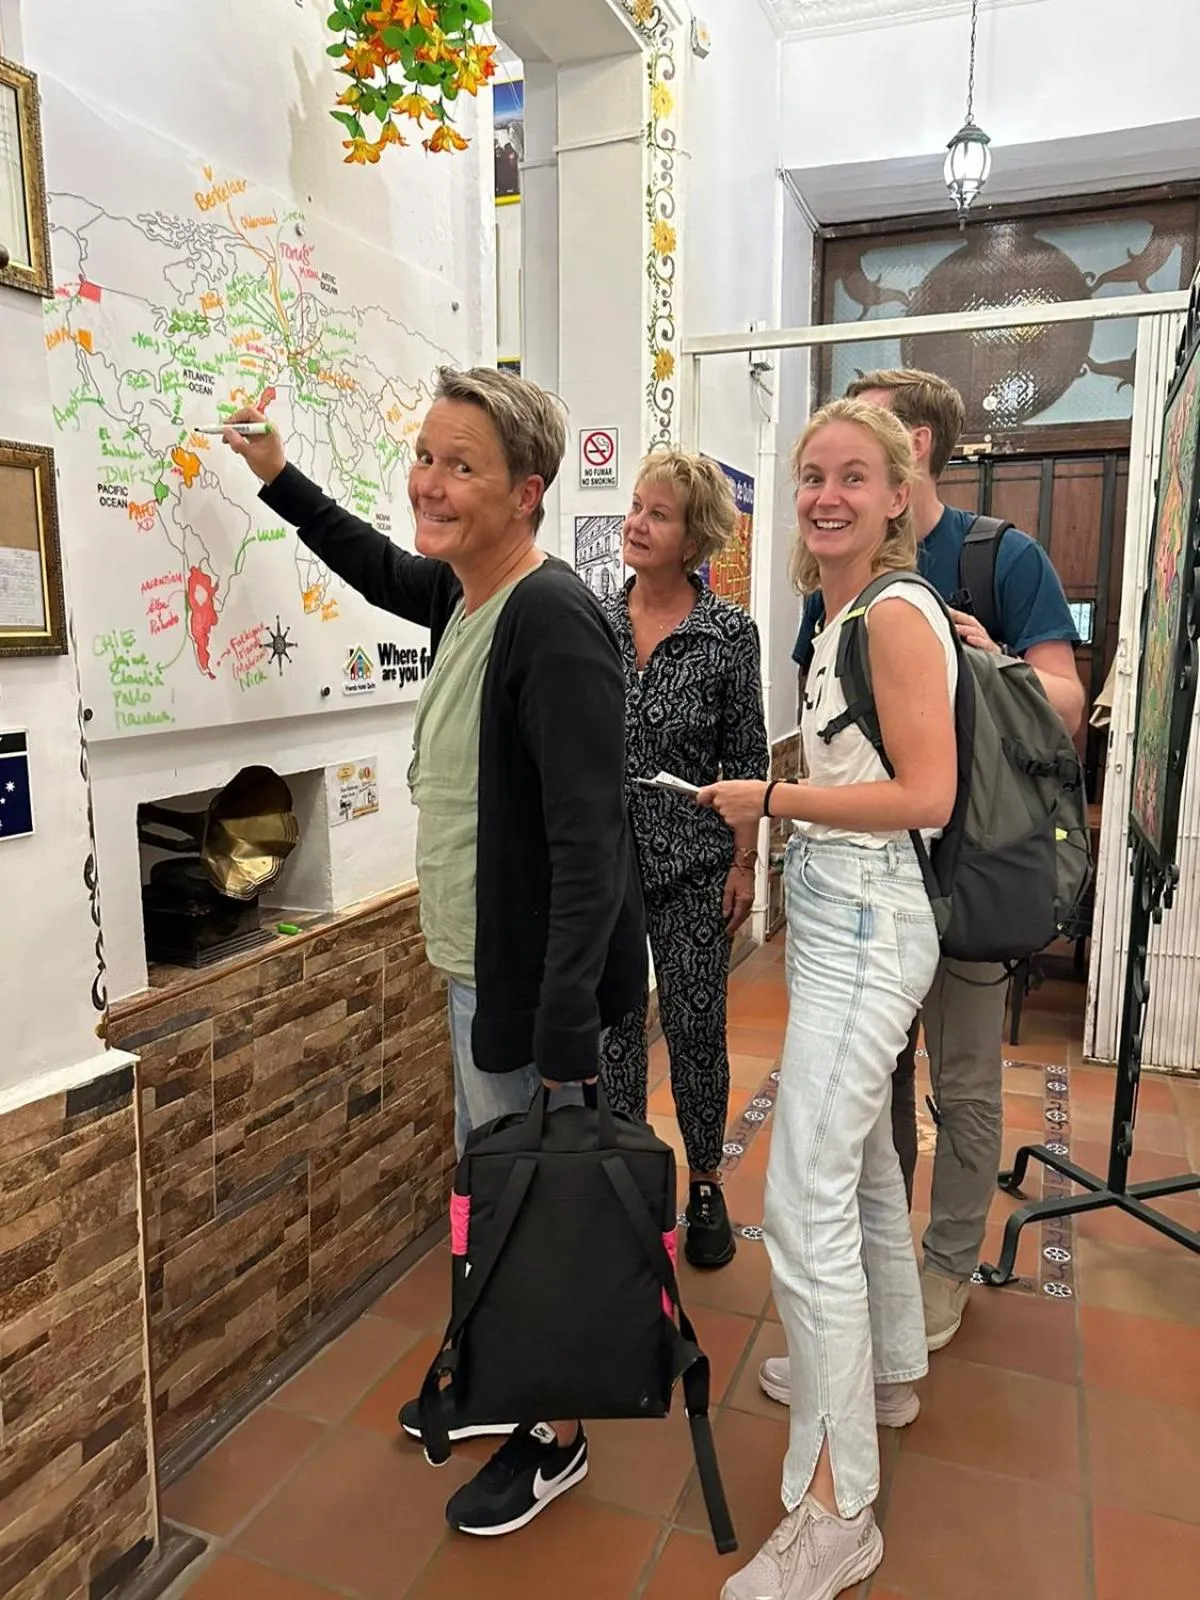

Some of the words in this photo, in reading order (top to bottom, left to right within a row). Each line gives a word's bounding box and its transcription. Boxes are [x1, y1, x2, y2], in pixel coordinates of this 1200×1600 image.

[320, 281, 338, 296] OCEAN
[183, 369, 215, 385] ATLANTIC
[188, 382, 213, 396] OCEAN
[585, 468, 593, 477] NO
[594, 467, 612, 477] FUMAR
[591, 477, 616, 486] SMOKING
[97, 483, 129, 496] PACIFIC
[99, 496, 128, 509] OCEAN
[377, 642, 418, 666] Where
[382, 668, 397, 681] are
[399, 665, 418, 688] you
